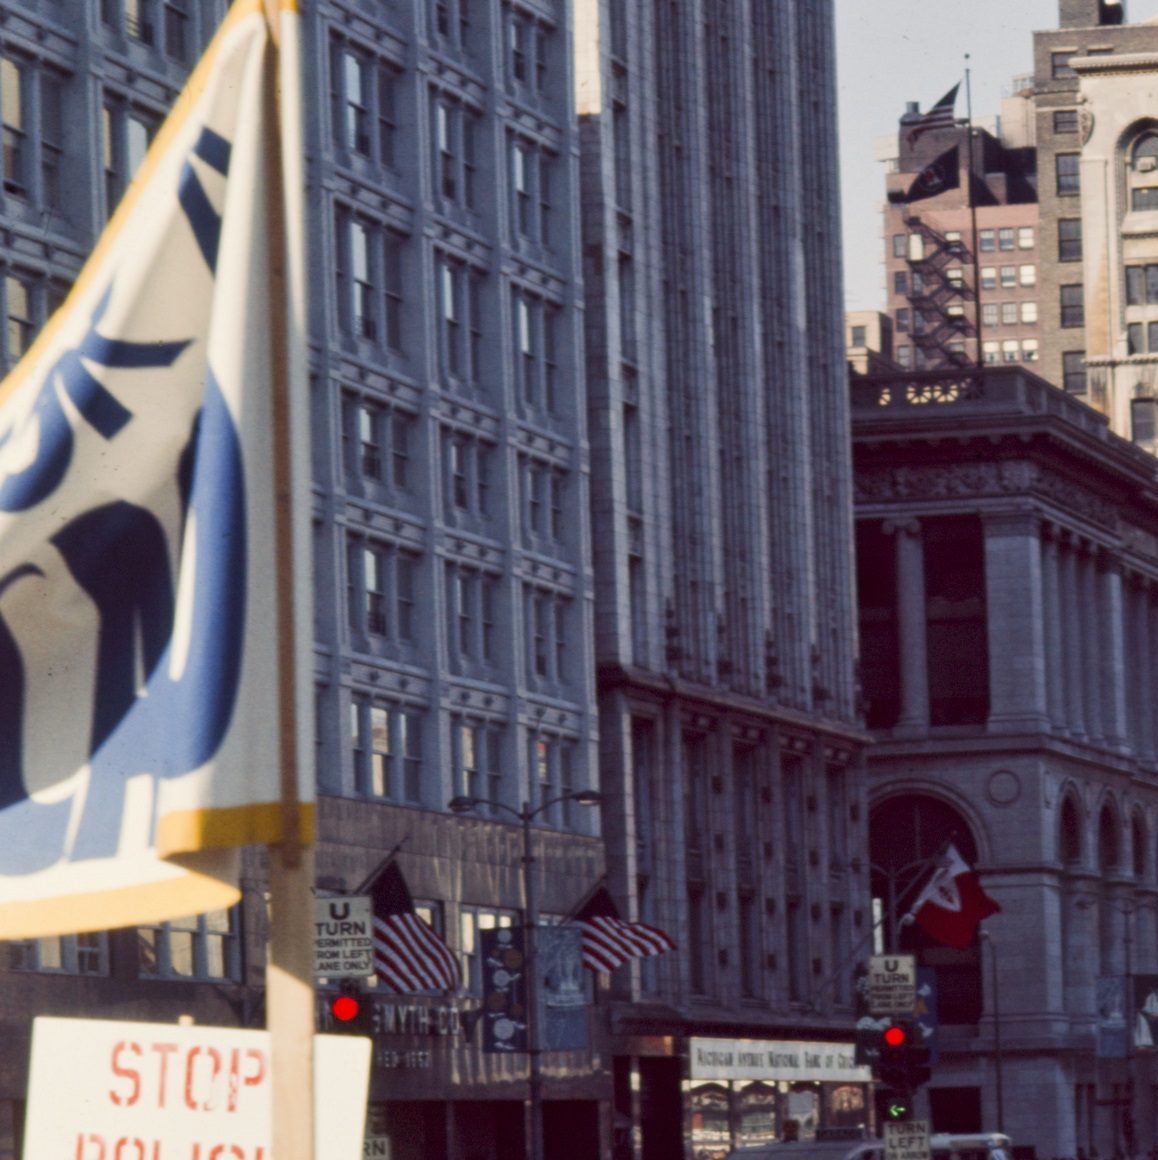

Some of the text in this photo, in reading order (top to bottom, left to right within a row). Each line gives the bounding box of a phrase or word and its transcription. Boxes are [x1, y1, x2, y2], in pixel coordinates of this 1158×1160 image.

[329, 902, 349, 920] U
[315, 921, 366, 936] TURN
[317, 949, 371, 960] ROM LEFT
[318, 961, 370, 972] ANE ONLY
[884, 960, 899, 973] U
[873, 973, 909, 984] TURN
[108, 1041, 269, 1113] STOP
[887, 1124, 926, 1135] TURN
[888, 1136, 925, 1150] LEFT
